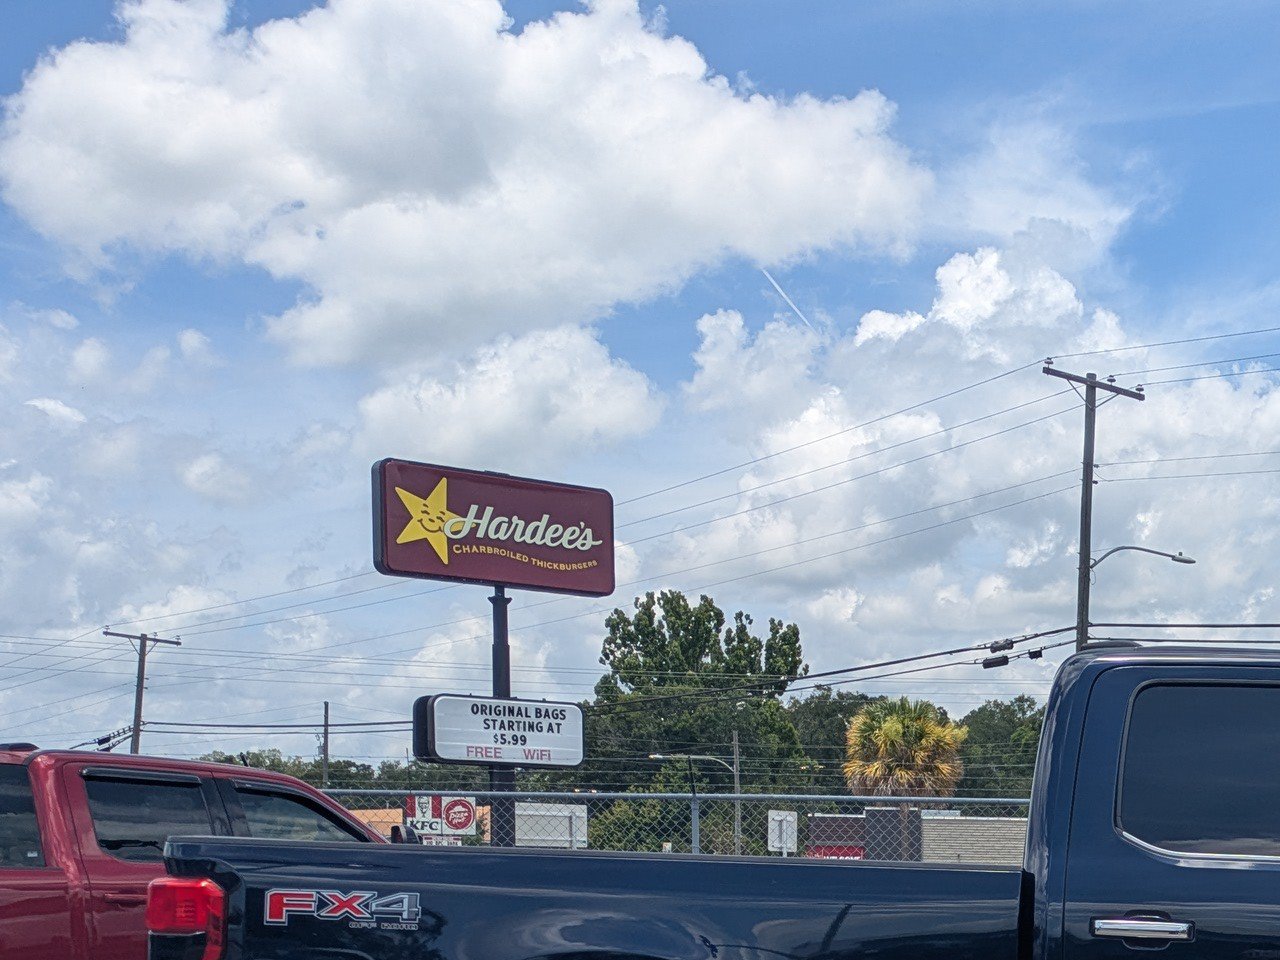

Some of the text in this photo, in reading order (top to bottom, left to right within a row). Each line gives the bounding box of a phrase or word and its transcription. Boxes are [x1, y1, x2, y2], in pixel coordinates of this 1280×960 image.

[443, 504, 603, 551] Hardee's
[452, 543, 598, 571] CHARBROILED THICKBURGERS
[471, 703, 567, 721] ORIGINAL BAGS
[483, 718, 563, 734] STARTING AT
[493, 733, 527, 746] $5.99
[466, 745, 503, 759] FREE
[410, 821, 439, 831] KFC
[264, 888, 422, 926] FX4
